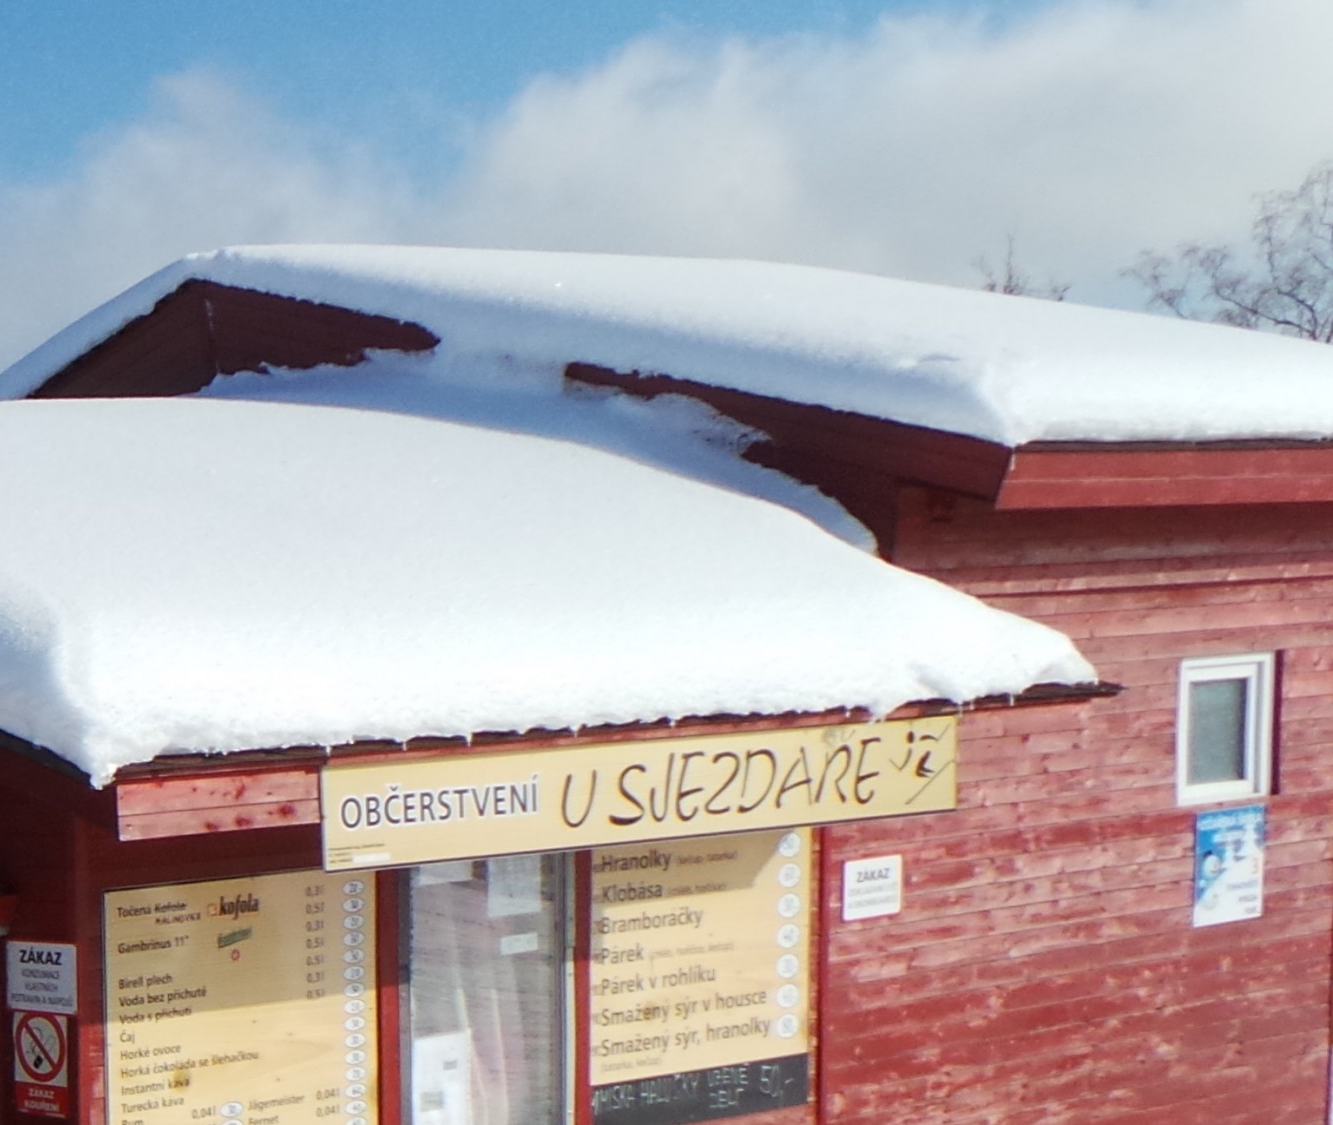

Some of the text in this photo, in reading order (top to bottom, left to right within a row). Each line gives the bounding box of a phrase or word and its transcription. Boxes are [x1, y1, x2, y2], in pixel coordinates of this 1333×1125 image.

[341, 774, 538, 829] OBČERSTVENÍ
[561, 769, 597, 828] U
[601, 850, 671, 873] Hranolky
[602, 882, 663, 903] Klobása
[219, 893, 259, 920] kofola
[19, 946, 62, 966] ZÁKAZ
[118, 939, 172, 955] Gambrinus
[602, 943, 644, 965] Párek
[118, 972, 173, 990] Birell plech
[602, 965, 716, 996] Párek v rohlíku
[118, 992, 145, 1007] Voda
[147, 991, 165, 1004] bez
[601, 1002, 670, 1028] Smažený
[675, 998, 697, 1021] sýr
[702, 999, 711, 1012] v
[715, 990, 767, 1011] housce
[118, 1010, 145, 1025] Voda
[119, 1029, 136, 1044] Čaj
[601, 1029, 670, 1057] Smažený
[675, 1028, 701, 1050] sýr,
[706, 1016, 771, 1042] hranolky
[120, 1045, 181, 1061] Horké ovoce
[120, 1065, 151, 1079] Horká
[198, 1058, 209, 1068] se
[121, 1081, 165, 1096] Instantní
